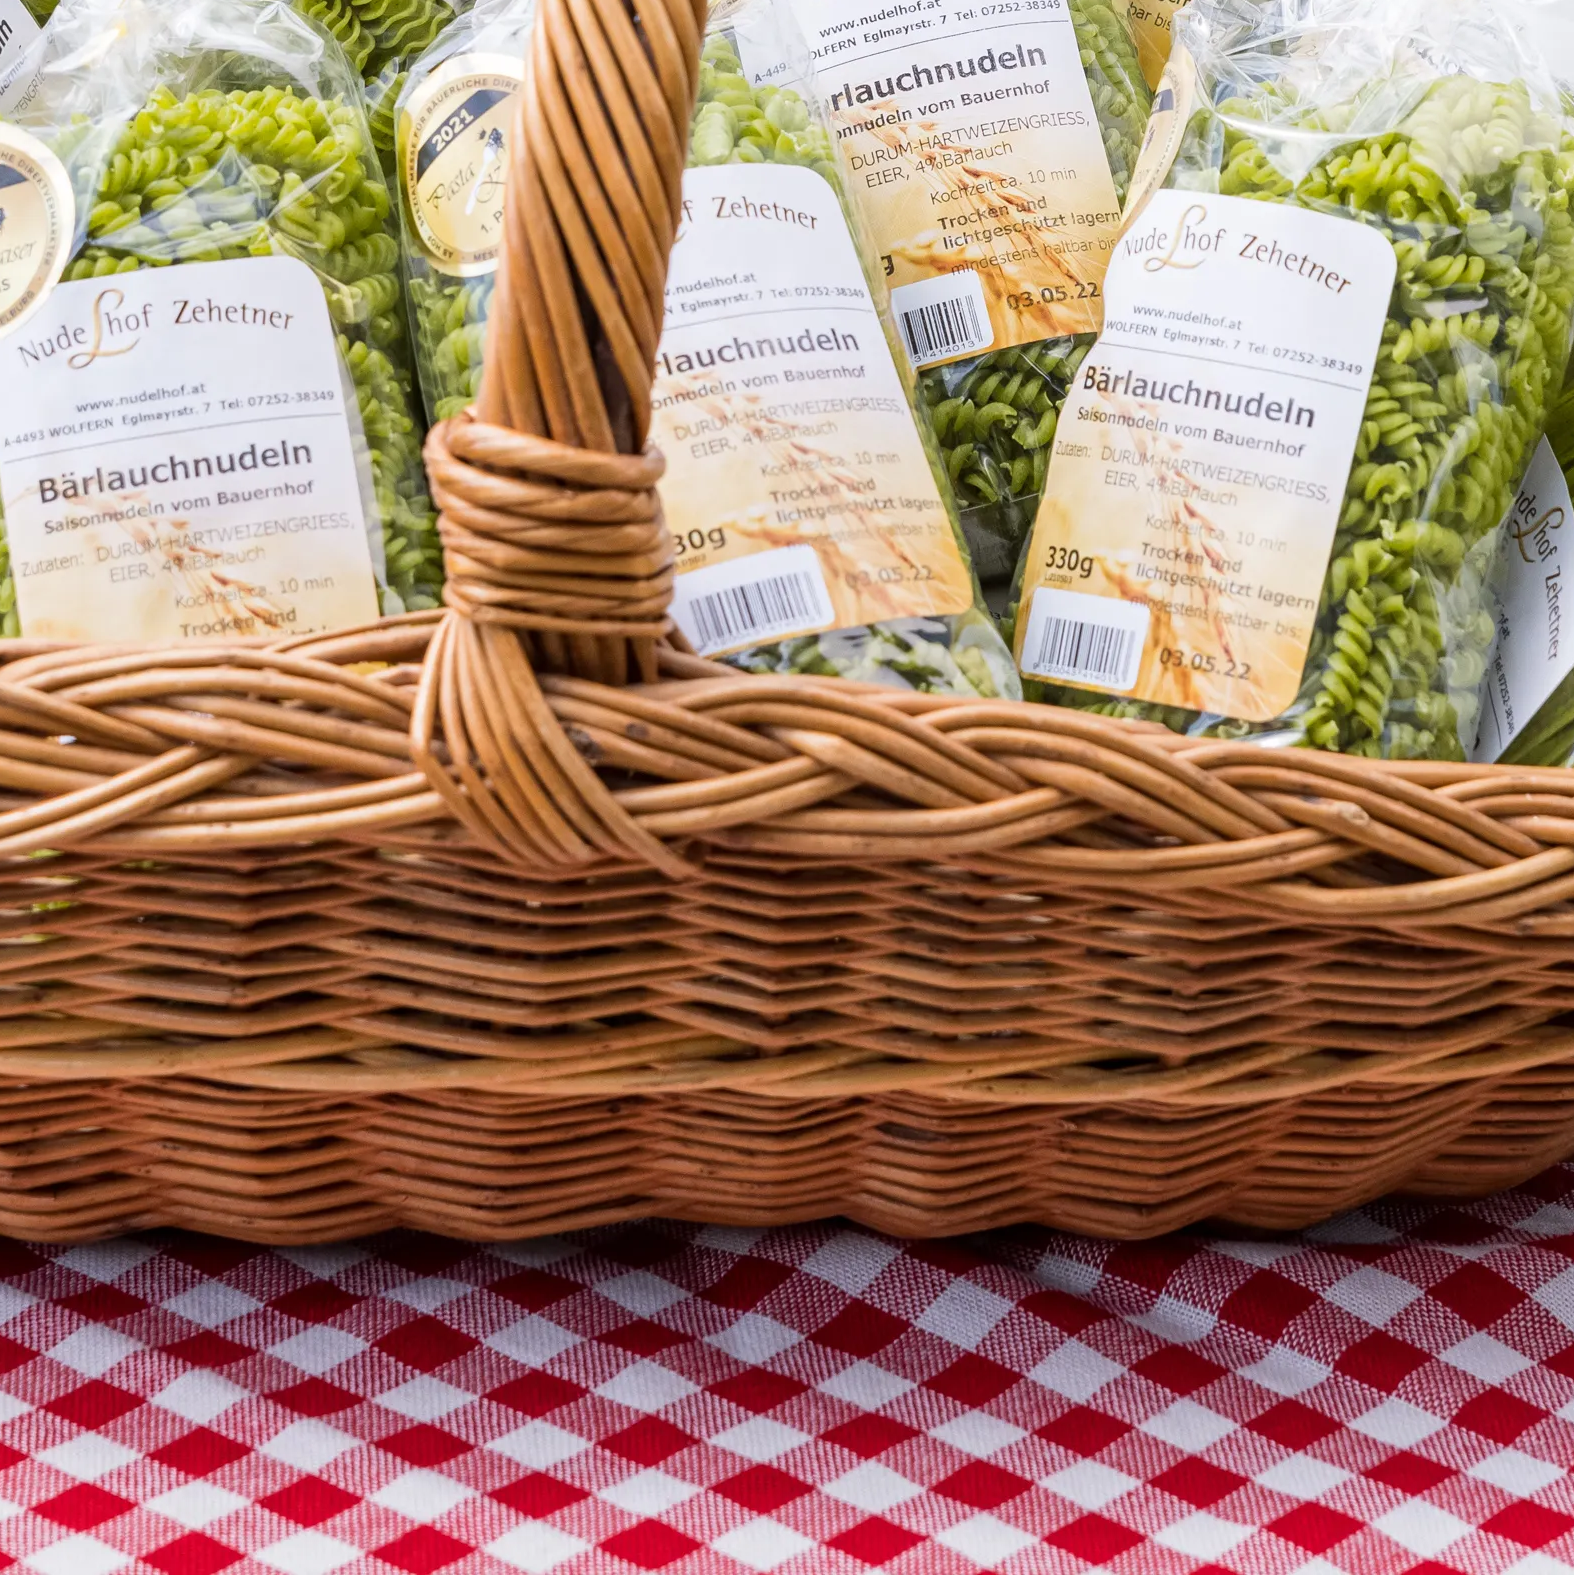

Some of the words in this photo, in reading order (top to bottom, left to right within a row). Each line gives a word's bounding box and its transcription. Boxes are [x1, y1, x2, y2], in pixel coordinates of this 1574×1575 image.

[863, 18, 936, 44] Eglmayrstr.
[940, 14, 948, 25] 7
[954, 8, 978, 21] Tel:
[426, 77, 489, 116] BÄUERLICHE
[918, 97, 956, 117] vom
[961, 79, 1051, 106] Bauernhof
[431, 107, 475, 153] 2021
[851, 110, 1090, 171] DURUM-HARTWEIZENGRIESS,
[426, 161, 475, 210] Pasta
[865, 166, 911, 189] EIER,
[930, 180, 1002, 205] Kochzeit
[1000, 176, 1023, 190] ca.
[1028, 169, 1046, 184] 10
[1051, 166, 1077, 182] min
[712, 195, 818, 230] Zehetner
[937, 204, 1010, 231] Trocken
[1015, 196, 1047, 212] und
[943, 214, 1066, 250] lichtgeschützt
[1071, 211, 1121, 228] lagern
[951, 246, 1039, 276] mindestens
[1043, 238, 1094, 254] haltbar
[1239, 233, 1352, 295] Zehetner
[681, 290, 755, 313] Eglmayrstr.
[756, 290, 763, 301] 7
[771, 288, 793, 299] Tel:
[795, 286, 865, 299] 07252-38349
[1006, 282, 1102, 310] 03.05.22
[173, 299, 294, 330] Zehetner
[1133, 304, 1243, 331] www.nudelhof.at
[929, 340, 975, 358] 414013
[1106, 320, 1157, 337] WOLFERN
[1163, 328, 1229, 348] Eglmayrstr.
[1233, 340, 1241, 350] 7
[1248, 342, 1270, 356] Tel:
[1273, 347, 1363, 375] 07252-38349
[742, 373, 779, 389] vom
[783, 365, 866, 383] Bauernhof
[75, 382, 207, 414] www.nudelhof.at
[1083, 365, 1316, 428] Bärlauchnudeln
[3, 430, 45, 449] A-4493
[49, 416, 115, 439] WOLFERN
[121, 405, 199, 426] Eglmayrstr.
[203, 401, 212, 414] 7
[219, 398, 244, 412] Tel:
[247, 390, 335, 409] 07252-38349
[1077, 406, 1169, 433] Saisonnudeln
[1174, 423, 1207, 440] vom
[1213, 428, 1306, 458] Bauernhof
[690, 438, 737, 459] EIER,
[854, 451, 872, 466] 10
[875, 451, 901, 464] min
[39, 439, 314, 505] Bärlauchnudeln
[1056, 441, 1092, 459] Zutaten:
[1101, 445, 1331, 504] DURUM-HARTWEIZENGRIESS,
[1104, 471, 1140, 492] EIER,
[44, 501, 165, 535] Saisonnudeln
[171, 496, 211, 513] vom
[217, 479, 316, 506] Bauernhof
[770, 484, 841, 504] Trocken
[846, 478, 877, 492] und
[777, 497, 897, 524] lichtgeschützt
[1145, 514, 1204, 536] Kochzeit
[1236, 530, 1255, 547] 10
[1259, 536, 1288, 552] min
[21, 551, 85, 578] Zutaten:
[109, 564, 156, 584] EIER,
[1045, 545, 1095, 578] 330g
[1141, 542, 1205, 566] Trocken
[1210, 557, 1243, 574] und
[279, 576, 299, 594] 10
[305, 573, 335, 591] min
[845, 565, 936, 589] 03.05.22
[1136, 564, 1251, 599] lichtgeschützt
[1258, 585, 1316, 612] lagern
[180, 613, 255, 639] Trocken
[262, 607, 298, 629] und
[1130, 593, 1209, 621] mindestens
[1544, 565, 1564, 661] Zehetner
[1159, 647, 1252, 681] 03.05.22
